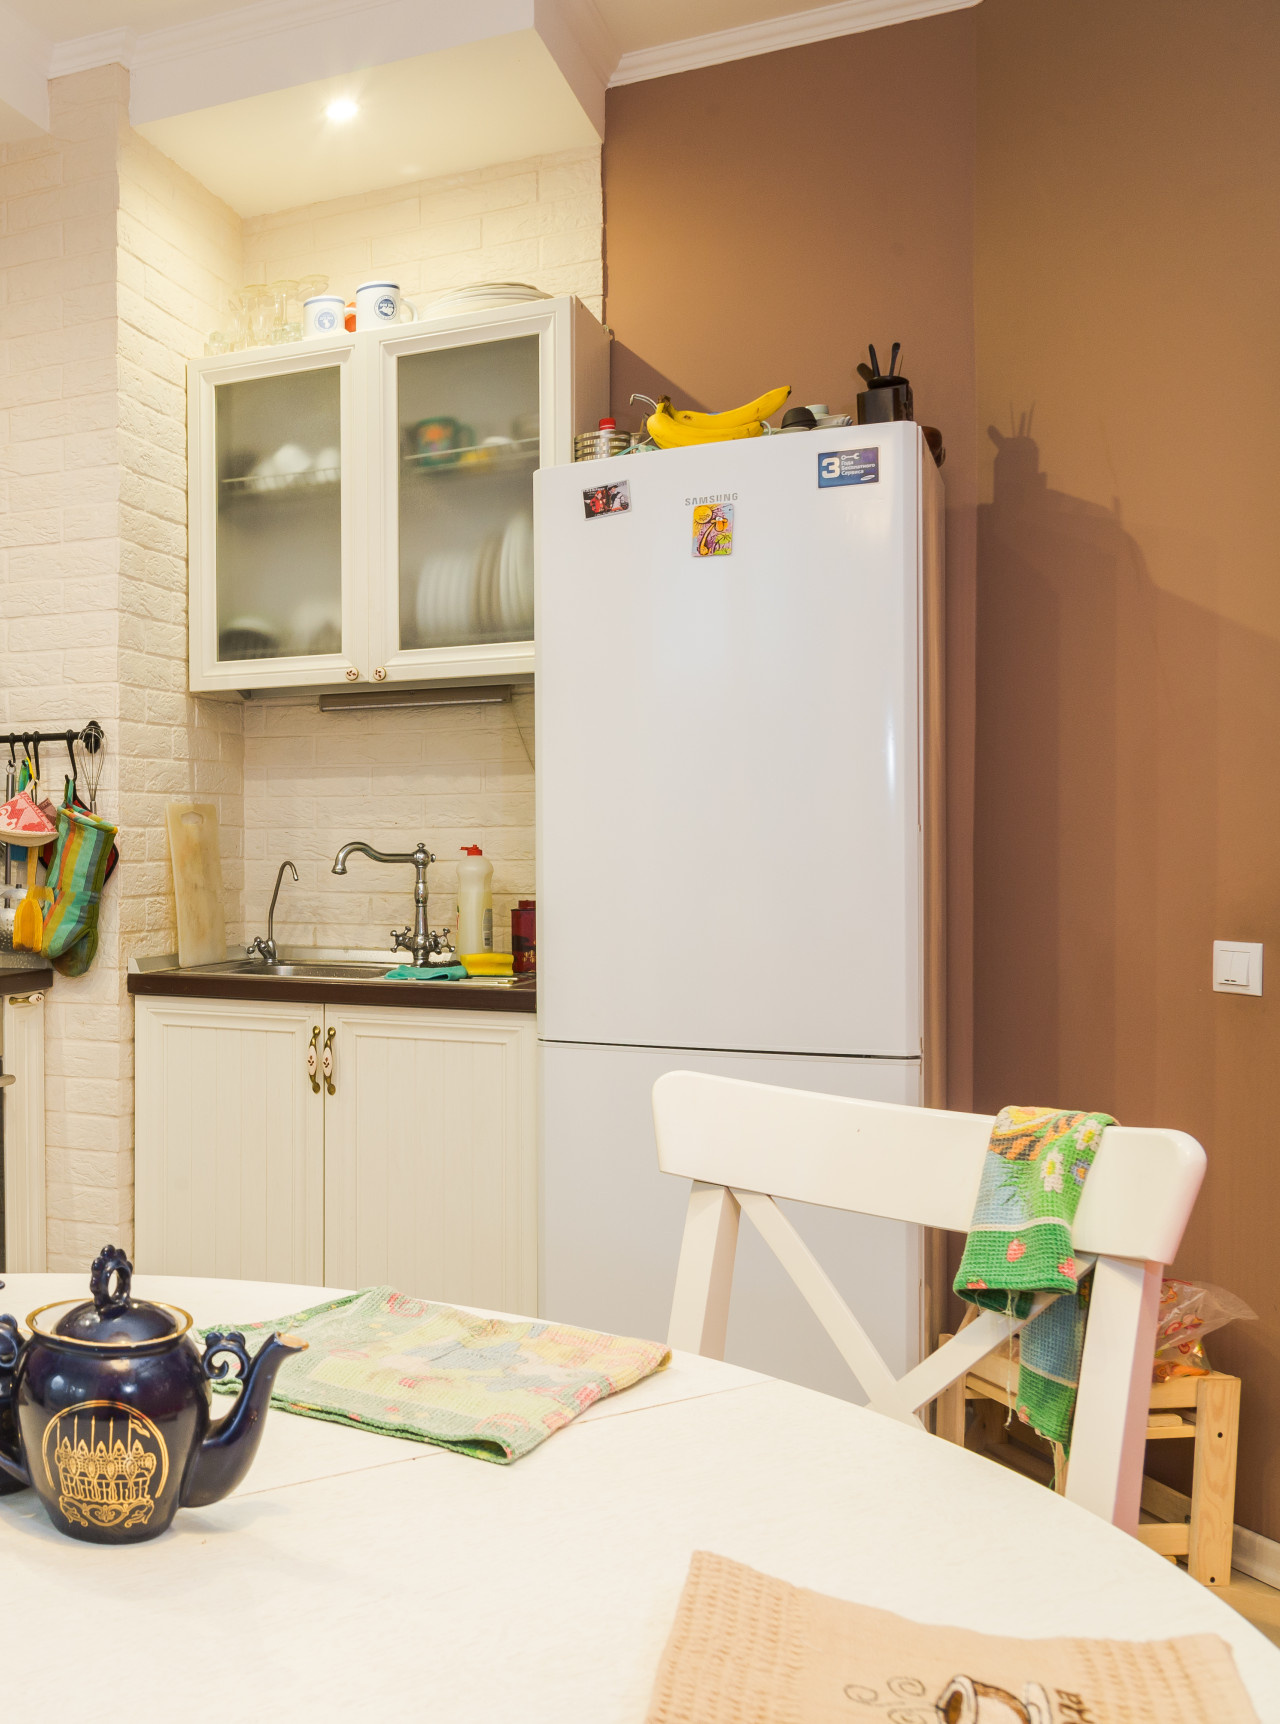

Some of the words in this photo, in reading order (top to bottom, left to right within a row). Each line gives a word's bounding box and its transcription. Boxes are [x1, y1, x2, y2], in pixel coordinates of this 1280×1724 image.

[821, 457, 841, 479] 3
[841, 463, 876, 471] Бесплатного
[684, 492, 738, 506] SAMSUNG
